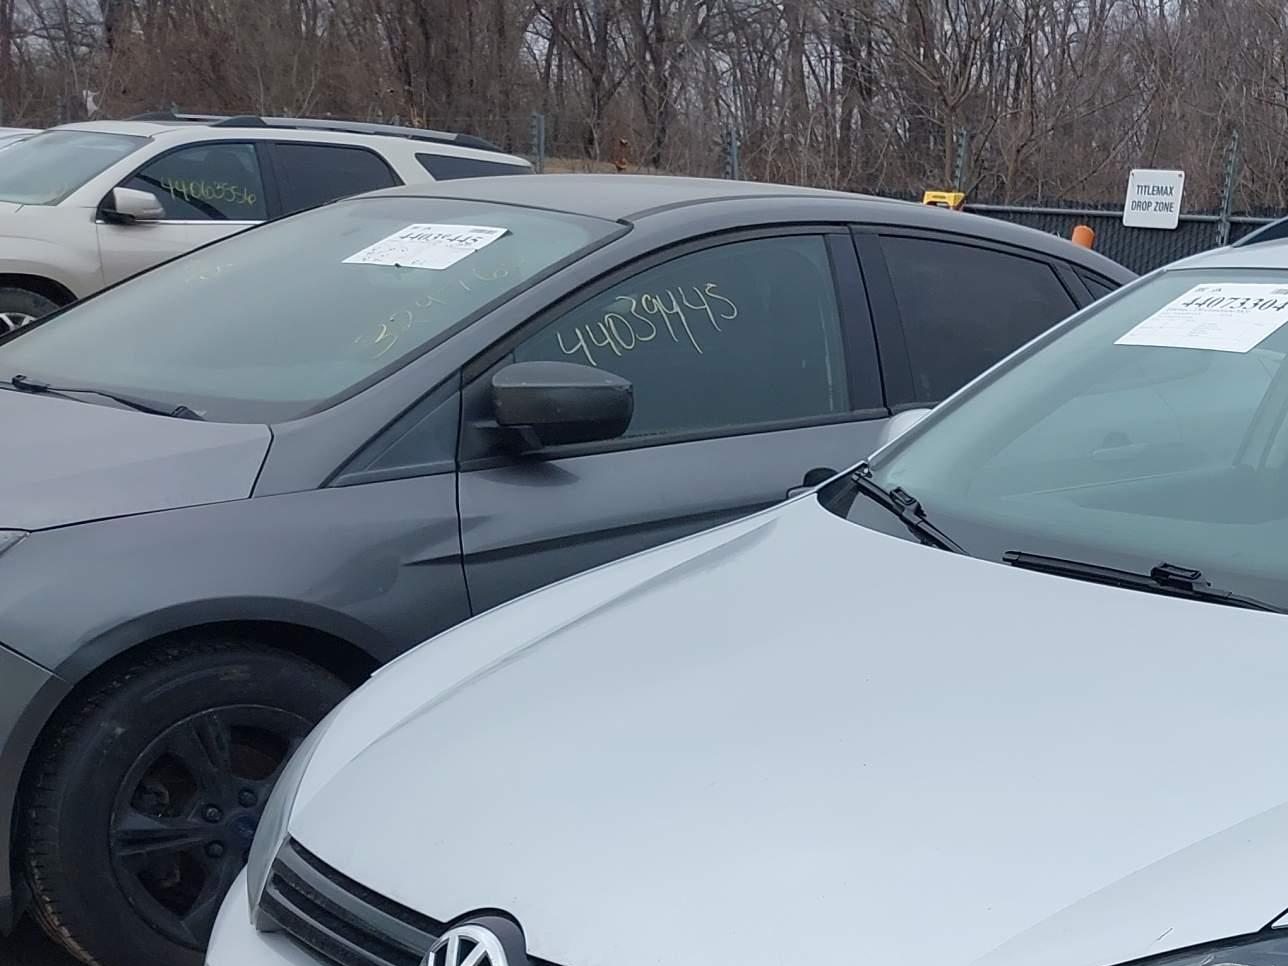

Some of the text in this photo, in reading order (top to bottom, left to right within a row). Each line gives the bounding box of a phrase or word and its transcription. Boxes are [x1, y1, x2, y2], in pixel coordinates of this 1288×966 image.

[1136, 184, 1174, 196] TITLEMAX
[1131, 200, 1175, 212] DROP ZONE
[557, 282, 738, 367] 44039445
